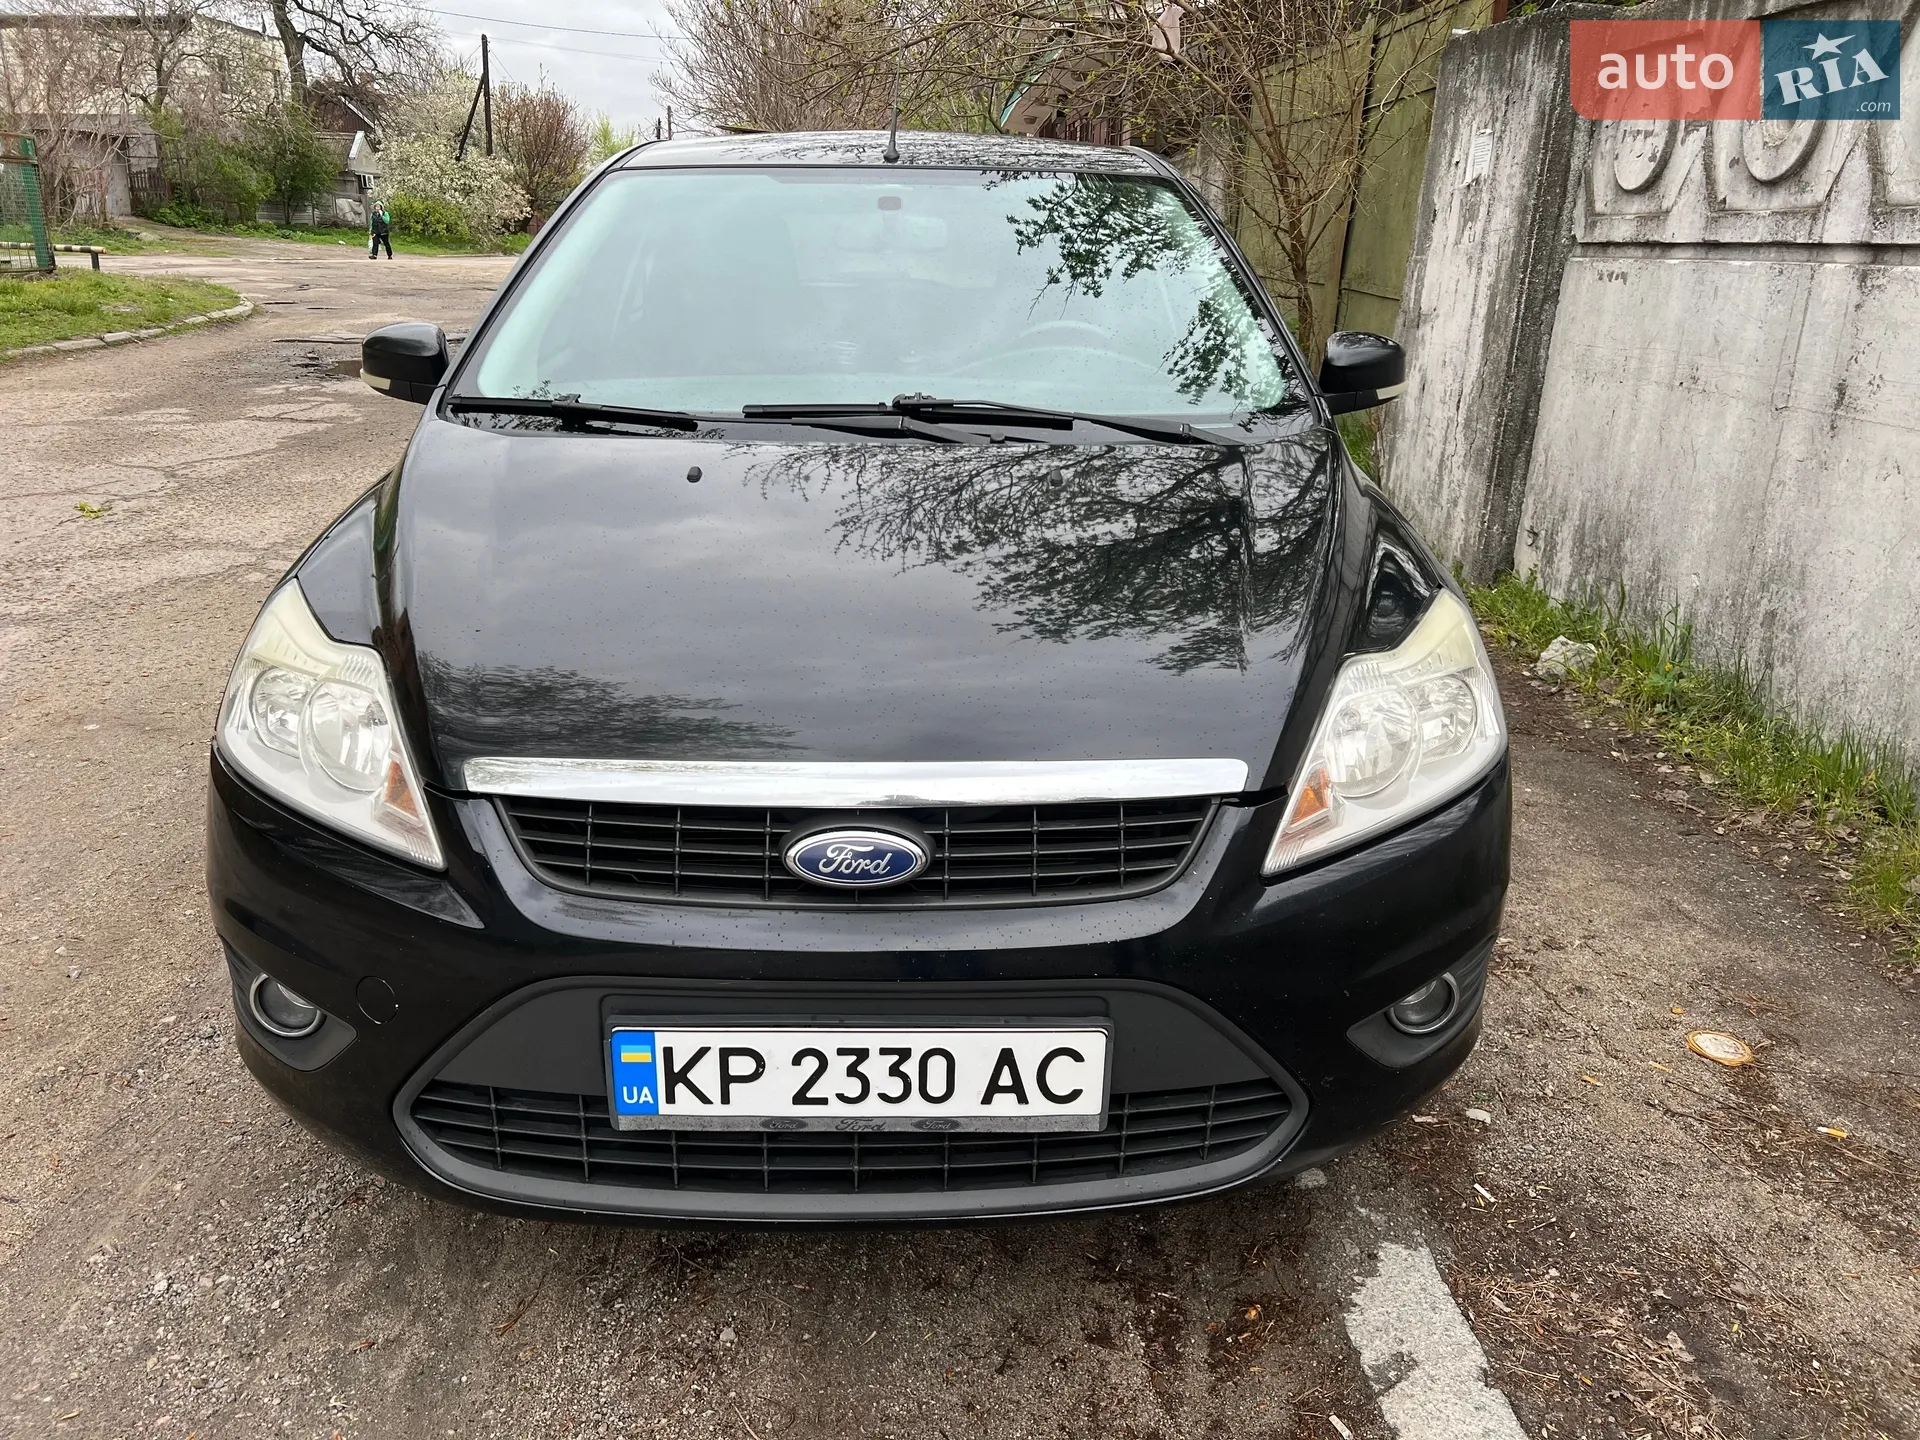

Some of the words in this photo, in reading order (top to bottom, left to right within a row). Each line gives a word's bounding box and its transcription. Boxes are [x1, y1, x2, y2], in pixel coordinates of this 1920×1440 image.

[818, 843, 893, 875] Ford
[662, 1046, 766, 1106] KP
[791, 1047, 956, 1106] 2330
[980, 1047, 1086, 1106] AC
[622, 1086, 654, 1105] UA
[769, 1118, 798, 1130] Ford
[835, 1118, 887, 1132] Ford
[922, 1118, 952, 1131] Ford
